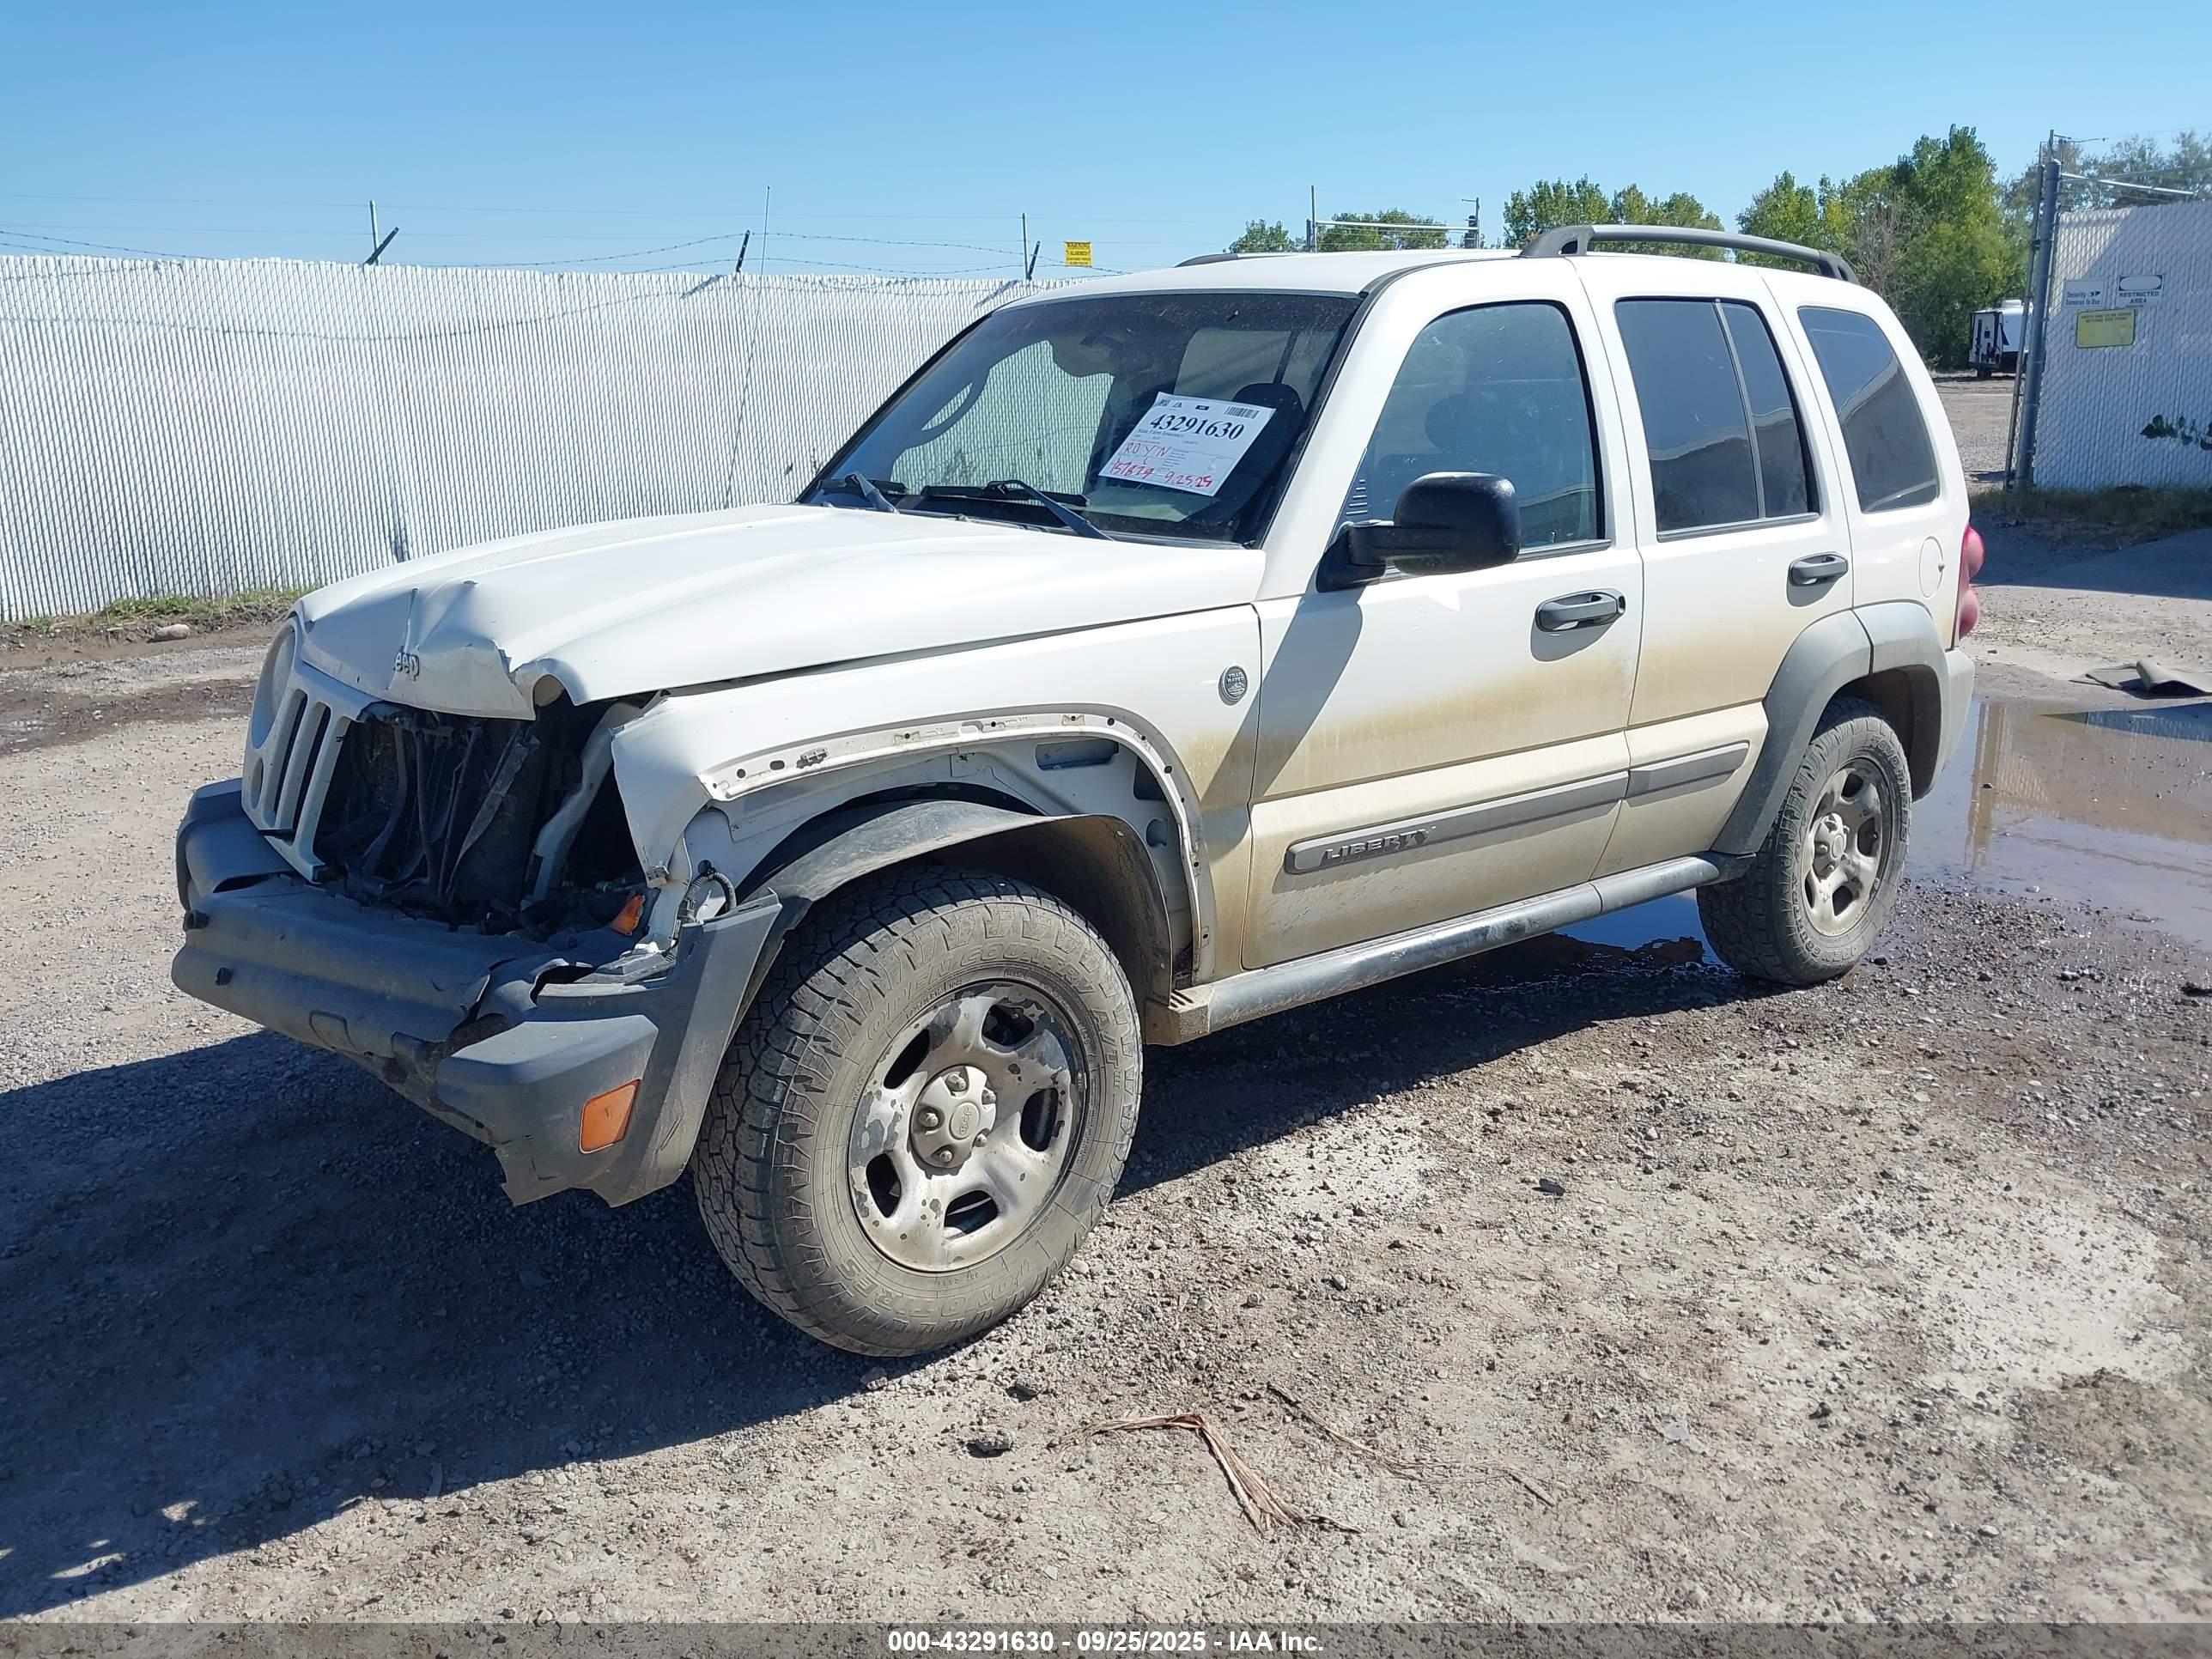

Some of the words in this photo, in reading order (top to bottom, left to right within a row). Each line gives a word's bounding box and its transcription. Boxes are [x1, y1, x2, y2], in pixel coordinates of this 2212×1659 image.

[1151, 414, 1244, 440] 43291630
[1320, 825, 1437, 864] LIBERTY
[959, 943, 1097, 994] COUNTRY
[956, 1107, 973, 1136] Jeep
[836, 1259, 933, 1319] TIRES
